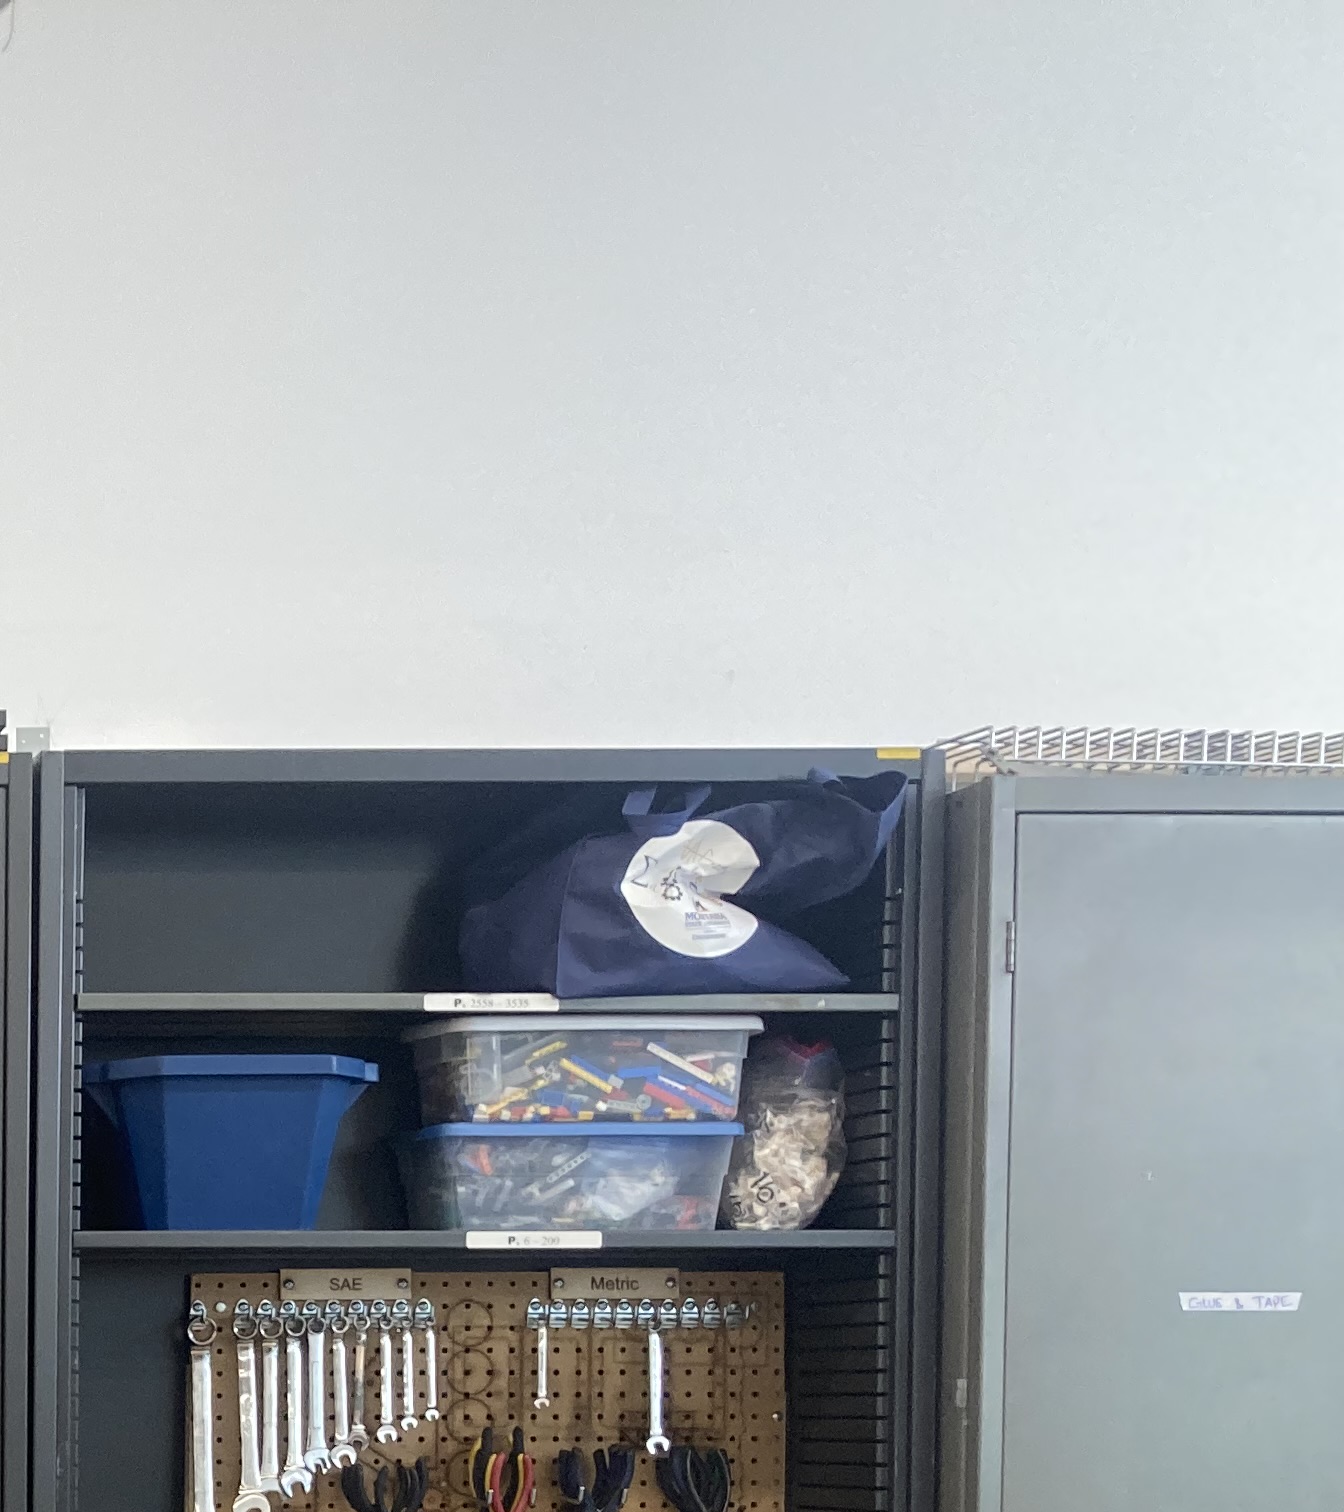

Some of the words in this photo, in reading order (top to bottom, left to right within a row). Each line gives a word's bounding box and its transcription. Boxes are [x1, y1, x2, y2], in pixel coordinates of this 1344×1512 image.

[330, 1277, 363, 1291] SAE
[591, 1276, 639, 1291] Metric
[1188, 1297, 1223, 1309] GLUE
[1252, 1295, 1293, 1309] TAPE
